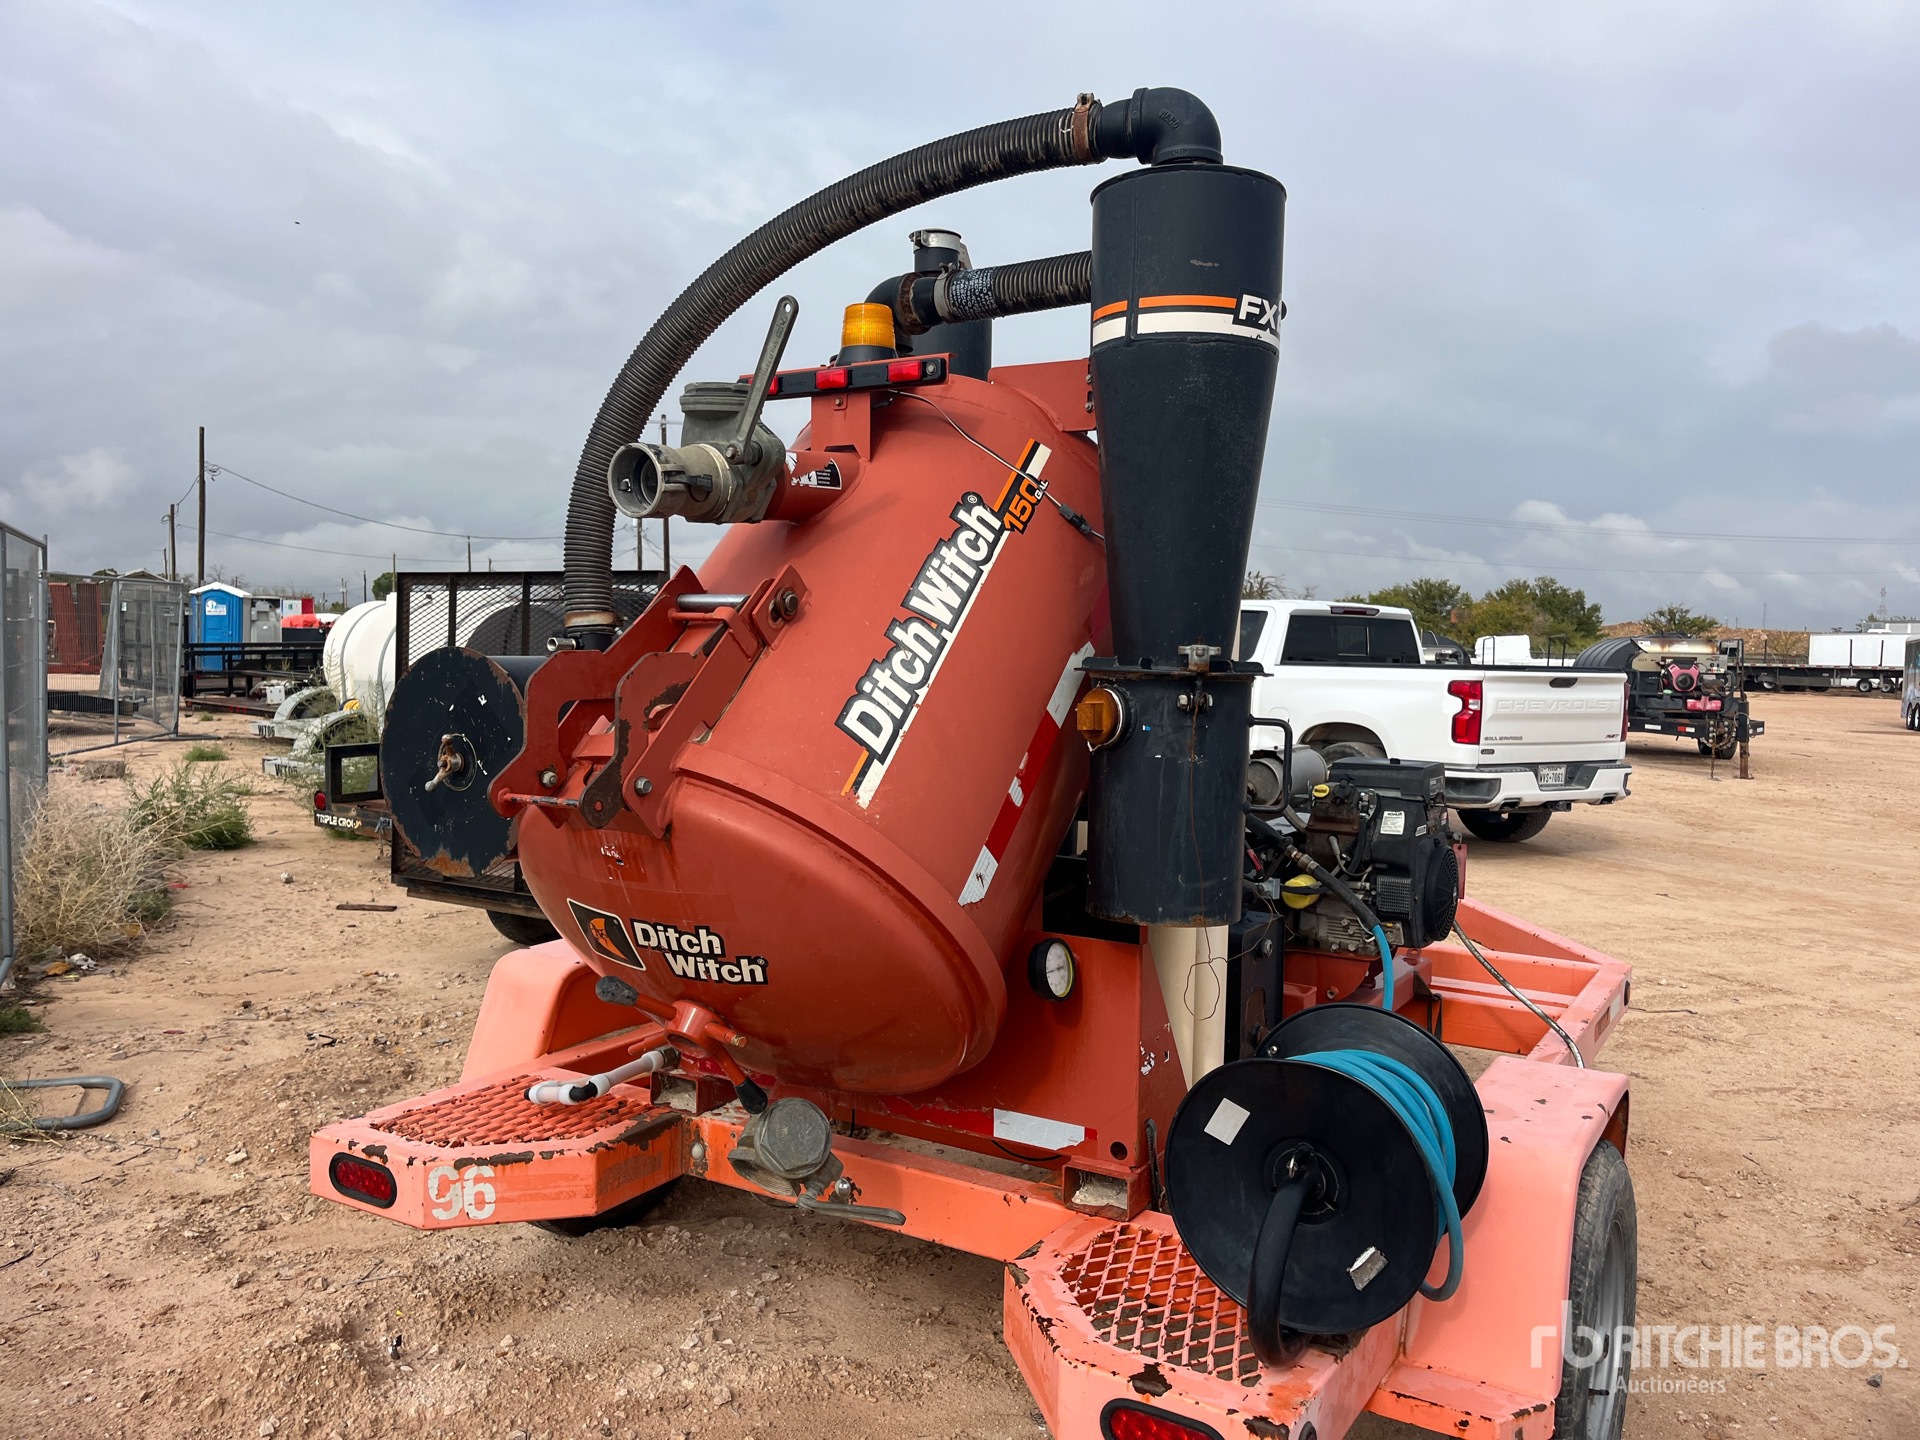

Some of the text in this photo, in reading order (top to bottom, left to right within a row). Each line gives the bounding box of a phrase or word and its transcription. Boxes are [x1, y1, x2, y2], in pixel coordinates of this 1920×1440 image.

[1239, 294, 1282, 332] FX
[1004, 479, 1039, 532] 150
[842, 617, 941, 755] Ditch
[1497, 699, 1619, 712] CHEVROLET
[633, 921, 722, 955] Ditch
[427, 1165, 496, 1221] 96
